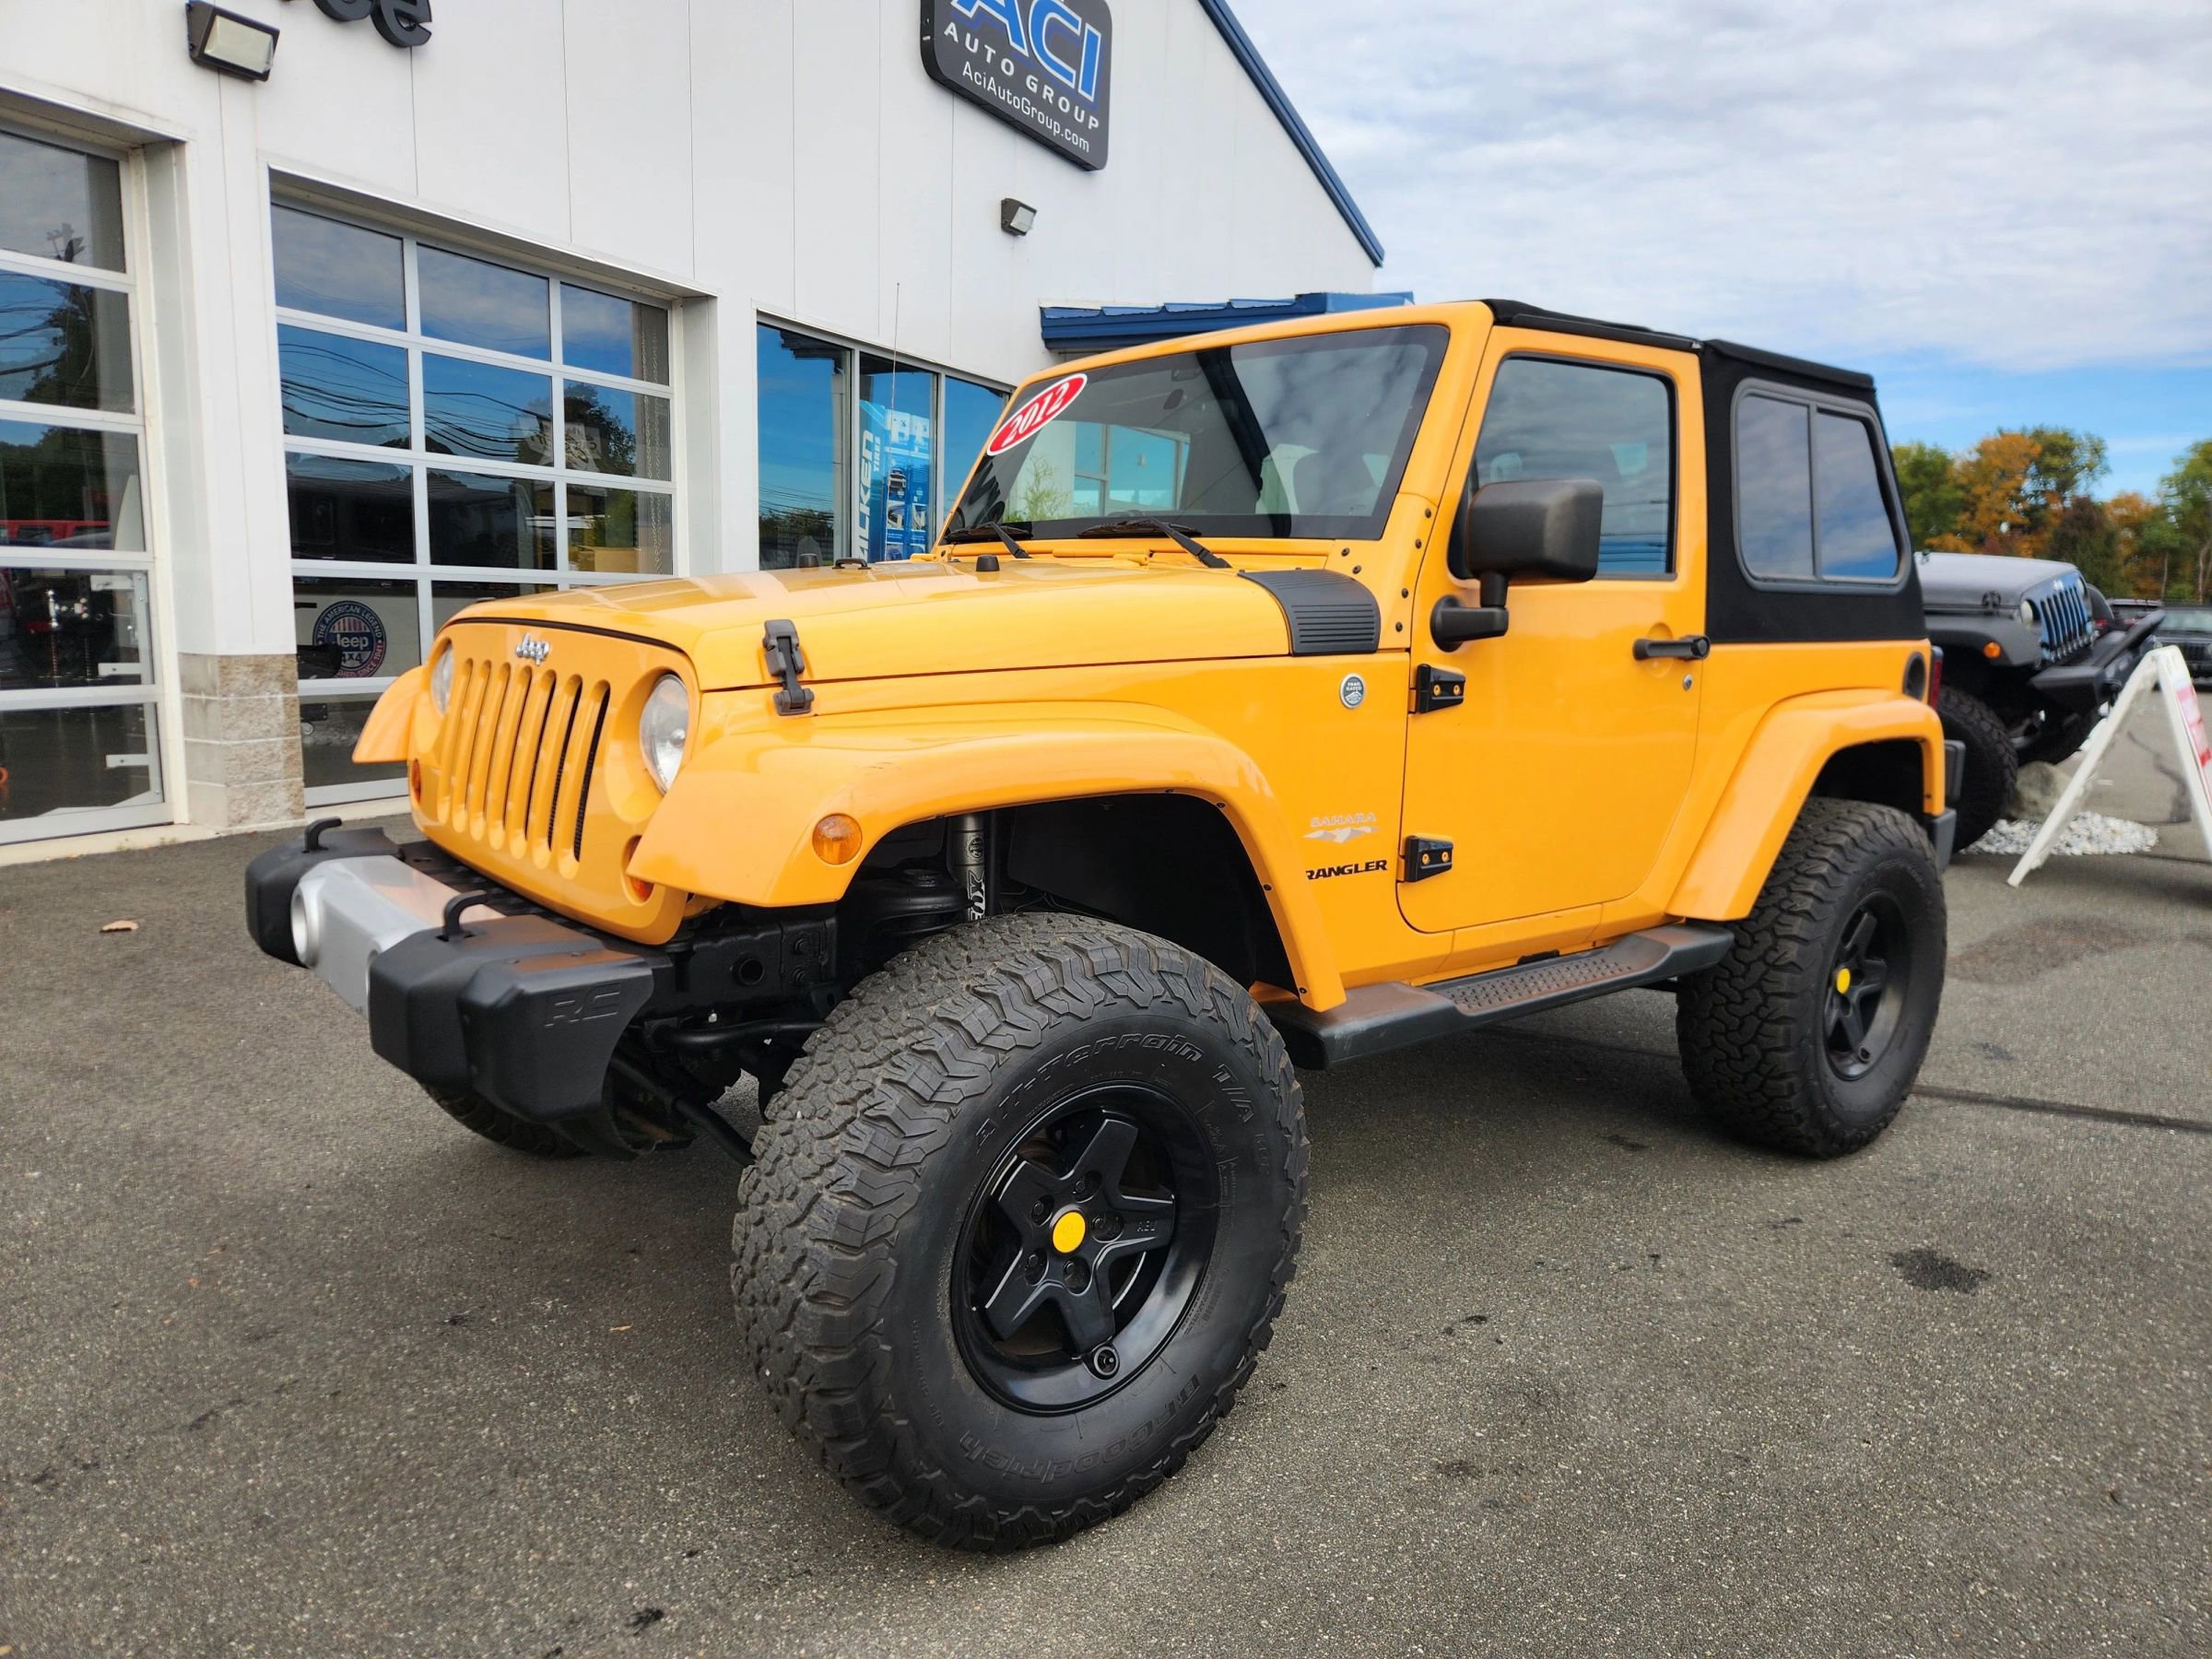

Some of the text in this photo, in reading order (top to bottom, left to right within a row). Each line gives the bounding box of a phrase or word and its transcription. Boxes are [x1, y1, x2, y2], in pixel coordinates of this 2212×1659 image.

[944, 21, 1100, 130] AUTO GROUP
[951, 0, 1102, 102] ACI
[962, 61, 1090, 153] AciAutoGroup.com
[1001, 382, 1069, 448] 2012
[858, 429, 874, 559] ALKEN
[318, 605, 382, 639] THE AMERICAN LEGEND
[333, 633, 370, 651] Jeep
[1311, 812, 1376, 828] SAHARA
